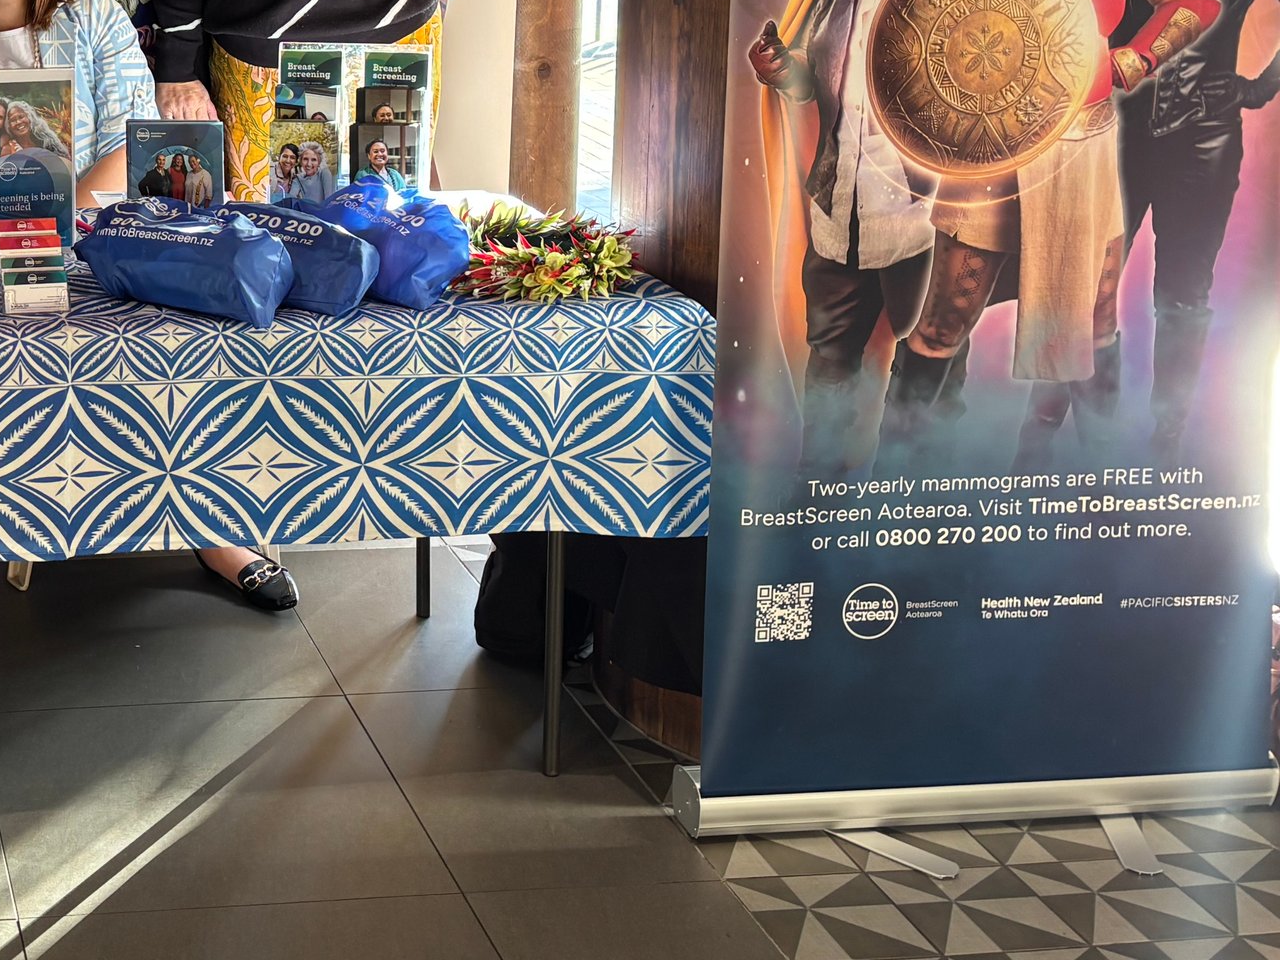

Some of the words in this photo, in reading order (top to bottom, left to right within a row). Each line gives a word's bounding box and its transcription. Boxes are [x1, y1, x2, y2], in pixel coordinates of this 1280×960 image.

[287, 62, 316, 70] Breast
[373, 63, 402, 73] Breast
[287, 69, 331, 80] screening
[372, 72, 417, 82] screening
[40, 192, 65, 202] being
[284, 220, 323, 236] 200
[808, 476, 916, 499] Two-yearly
[922, 473, 1060, 493] mammograms
[1066, 473, 1097, 487] are
[1103, 468, 1153, 486] FREE
[1160, 467, 1203, 484] with
[740, 505, 871, 527] BreastScreen
[877, 503, 972, 521] Aotearoa.
[978, 499, 1022, 516] Visit
[1028, 493, 1261, 515] TimeToBreastScreen.nz
[811, 536, 832, 551] or
[837, 530, 870, 549] call
[875, 528, 932, 547] 0800
[936, 526, 976, 545] 270
[981, 525, 1022, 543] 200
[1028, 525, 1048, 541] to
[1054, 523, 1092, 540] find
[1098, 523, 1131, 538] out
[1136, 523, 1192, 538] more.
[848, 599, 880, 611] Time
[882, 598, 894, 609] to
[906, 600, 959, 609] BreastScreen
[981, 596, 1021, 609] Health
[1024, 595, 1051, 607] New
[1053, 593, 1104, 606] Zealand
[1120, 594, 1239, 608] #PACIFICSISTERSNZ
[845, 609, 895, 622] screen
[905, 610, 942, 619] Aotearoa
[981, 609, 992, 619] Te
[994, 609, 1028, 618] Whatu
[1030, 609, 1049, 618] Ora
